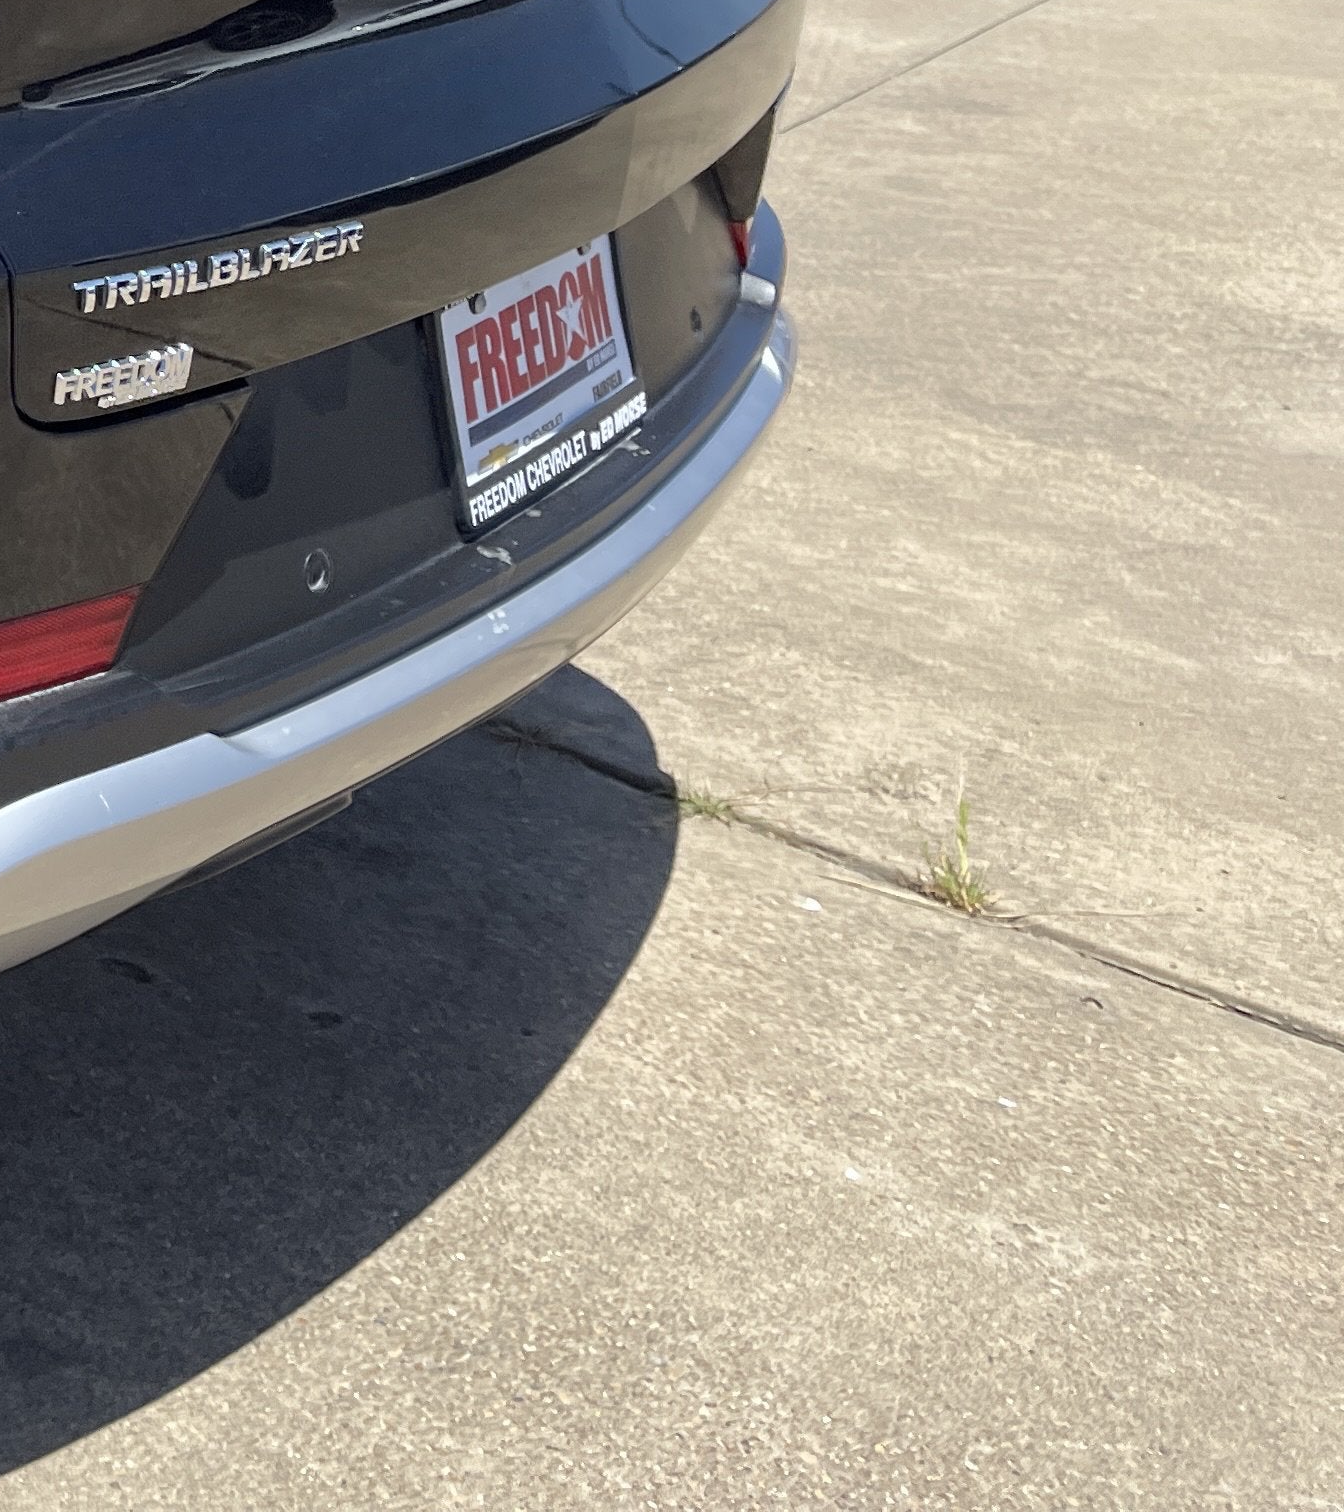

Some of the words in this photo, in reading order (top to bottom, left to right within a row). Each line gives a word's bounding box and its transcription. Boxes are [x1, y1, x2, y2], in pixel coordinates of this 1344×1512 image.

[72, 220, 364, 314] TRAILBLAZER
[454, 252, 613, 424] FREEDOM
[468, 469, 527, 527] FREEDOM
[525, 430, 588, 493] CHEVROLET
[599, 416, 615, 444] ED
[613, 392, 647, 435] MORSE
